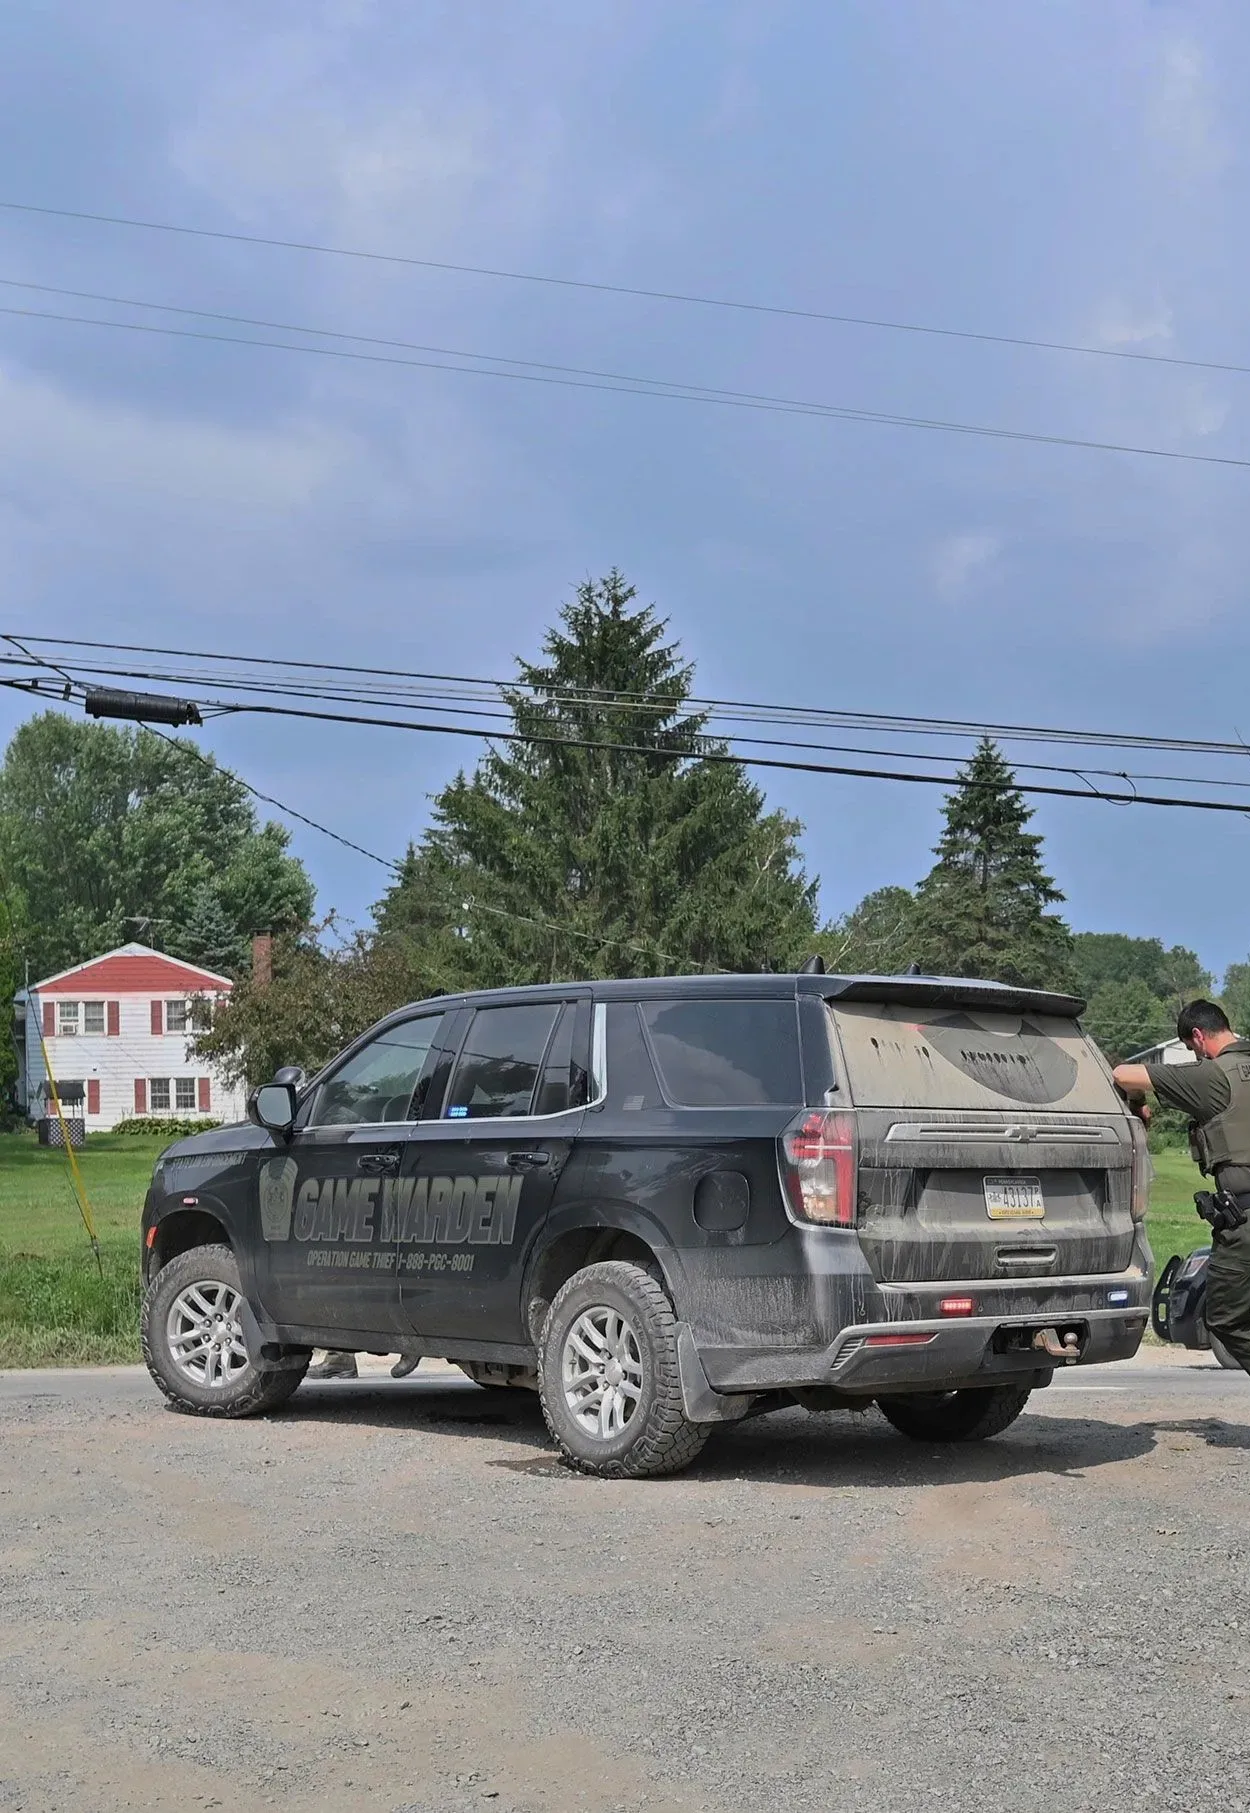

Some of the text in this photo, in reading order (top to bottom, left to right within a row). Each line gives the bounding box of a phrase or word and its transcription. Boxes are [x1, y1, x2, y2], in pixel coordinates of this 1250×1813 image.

[1003, 1187, 1034, 1208] 43137
[294, 1174, 525, 1245] GAME WARDEN
[307, 1251, 475, 1272] OPERATION GAME THIEF 1-888-PGC-8001
